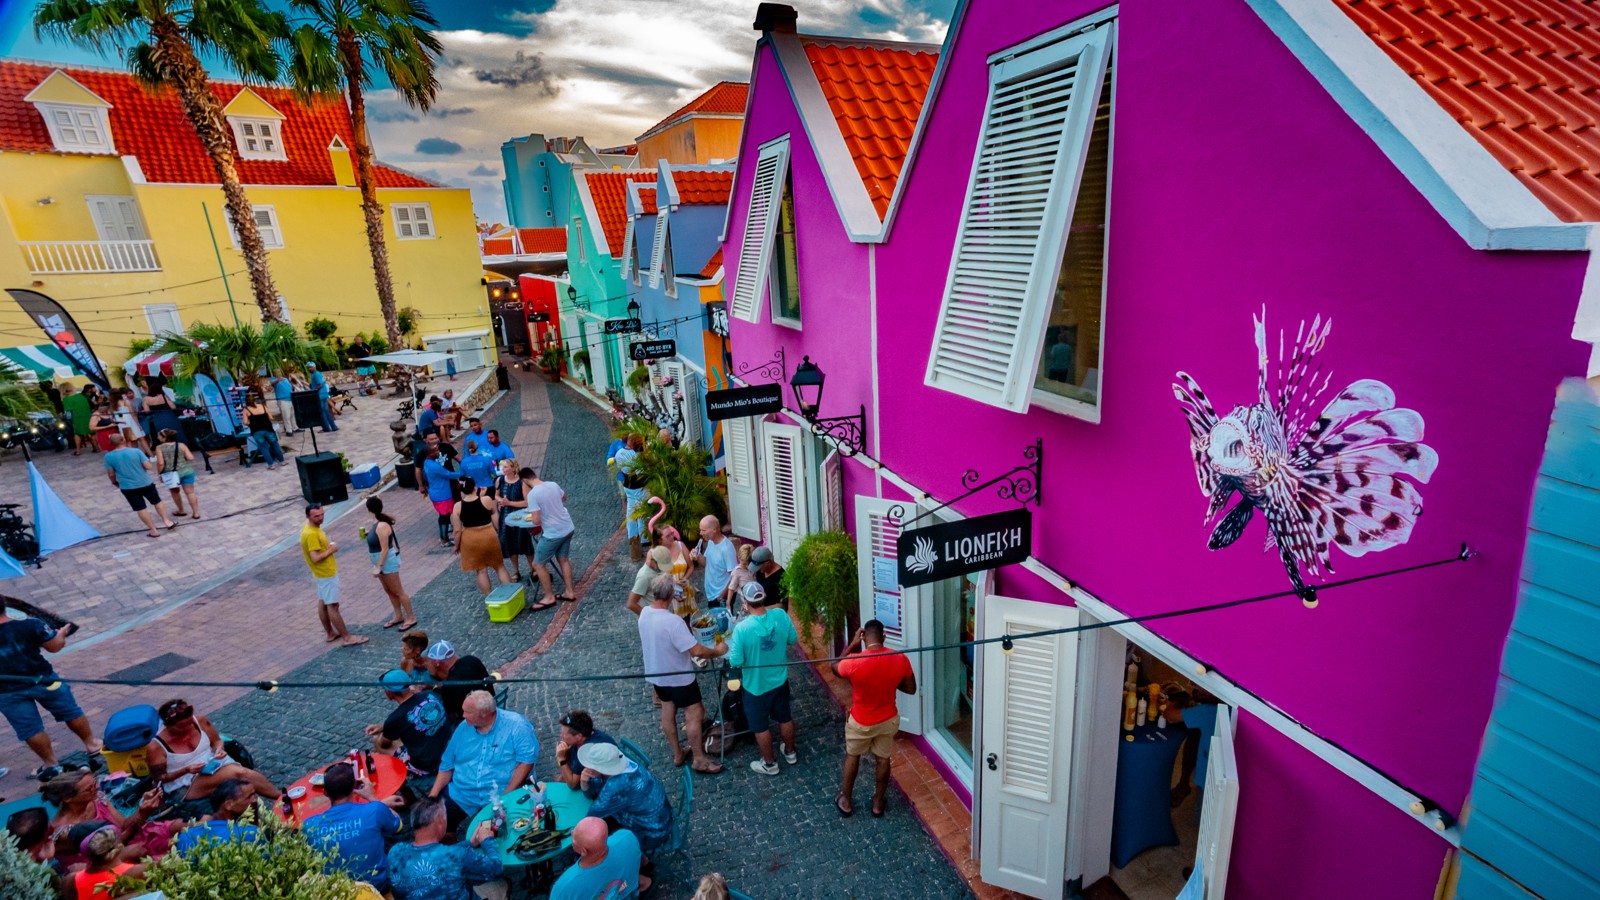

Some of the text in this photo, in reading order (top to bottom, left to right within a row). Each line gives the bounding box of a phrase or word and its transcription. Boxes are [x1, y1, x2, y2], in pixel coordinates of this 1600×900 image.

[710, 395, 779, 411] Mundo Mio's Boutique
[944, 527, 1022, 562] LIONFISH
[964, 550, 1003, 565] CARIBBEAN
[314, 817, 362, 837] IONFISH
